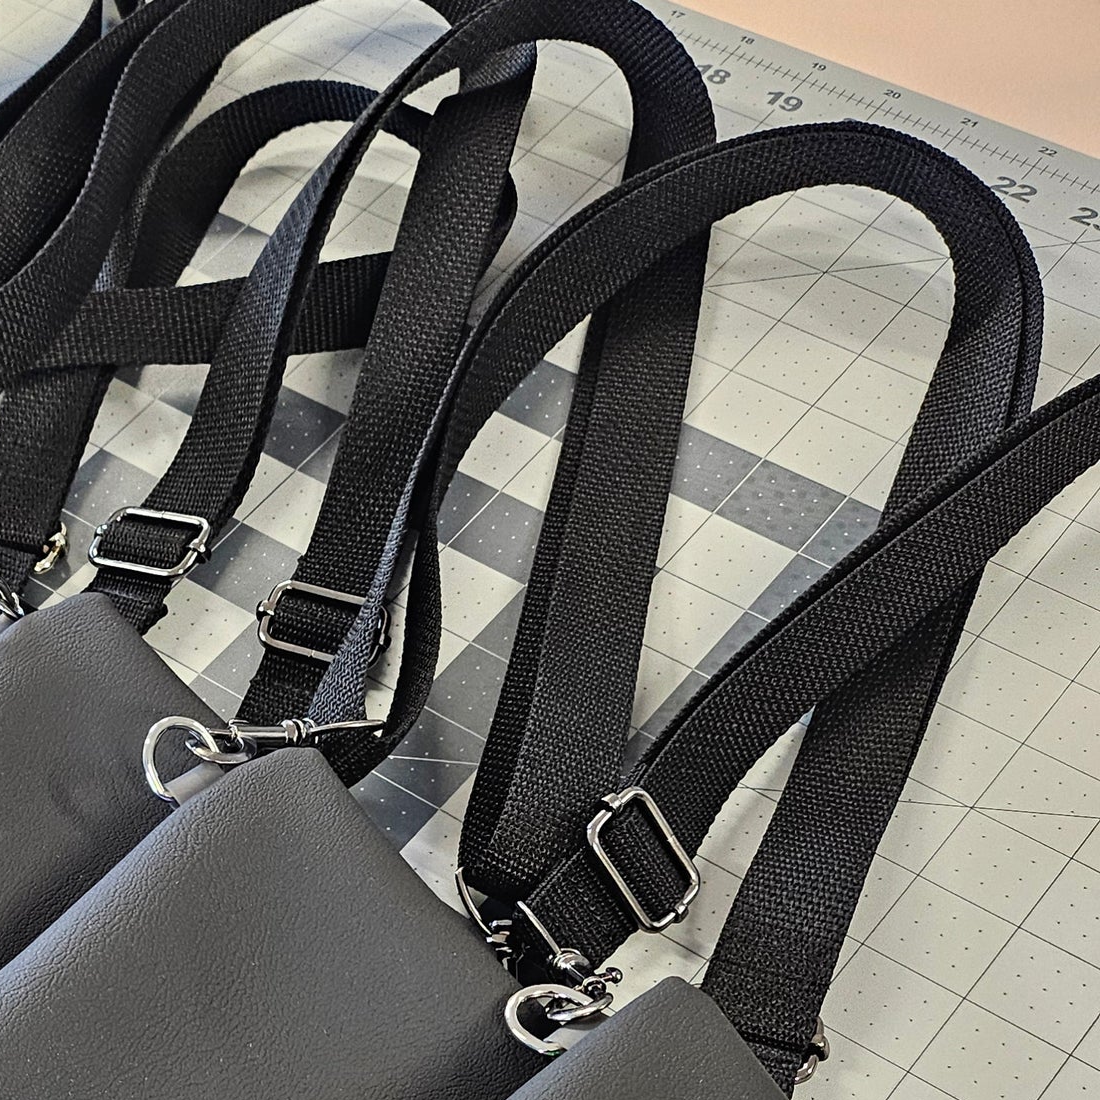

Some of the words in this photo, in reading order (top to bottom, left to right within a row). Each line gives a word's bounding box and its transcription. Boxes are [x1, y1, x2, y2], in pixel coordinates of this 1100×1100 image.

[670, 9, 687, 19] 17
[739, 35, 756, 46] 18
[811, 61, 828, 72] 19
[883, 88, 902, 100] 20
[960, 117, 980, 129] 21
[1038, 145, 1059, 158] 22
[766, 91, 804, 113] 19
[990, 176, 1039, 204] 22
